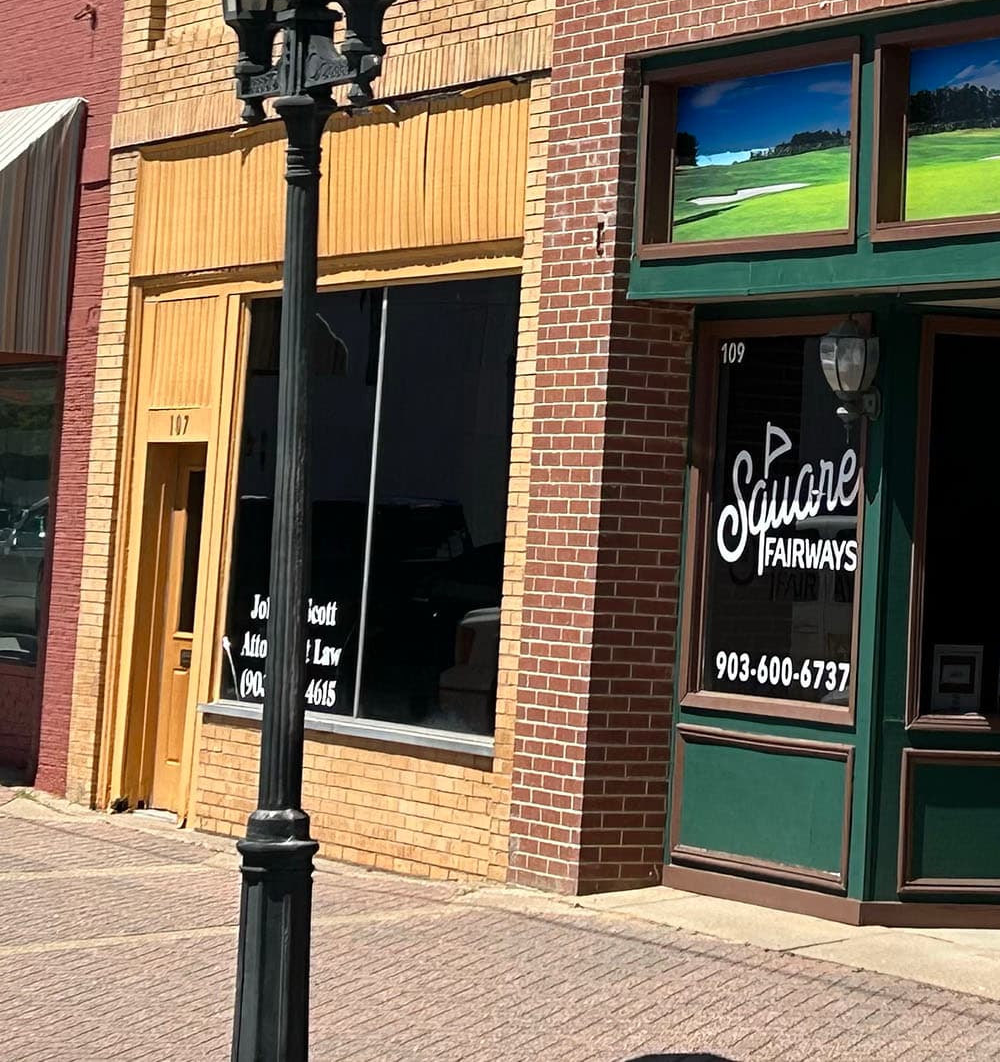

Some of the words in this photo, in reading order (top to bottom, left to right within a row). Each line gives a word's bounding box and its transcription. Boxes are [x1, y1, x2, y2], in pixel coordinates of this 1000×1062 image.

[720, 341, 746, 365] 109
[169, 416, 190, 435] 107
[716, 421, 861, 576] Square
[764, 536, 858, 572] FAIRWAYS
[313, 639, 342, 667] Law
[715, 651, 851, 692] 903-600-6737
